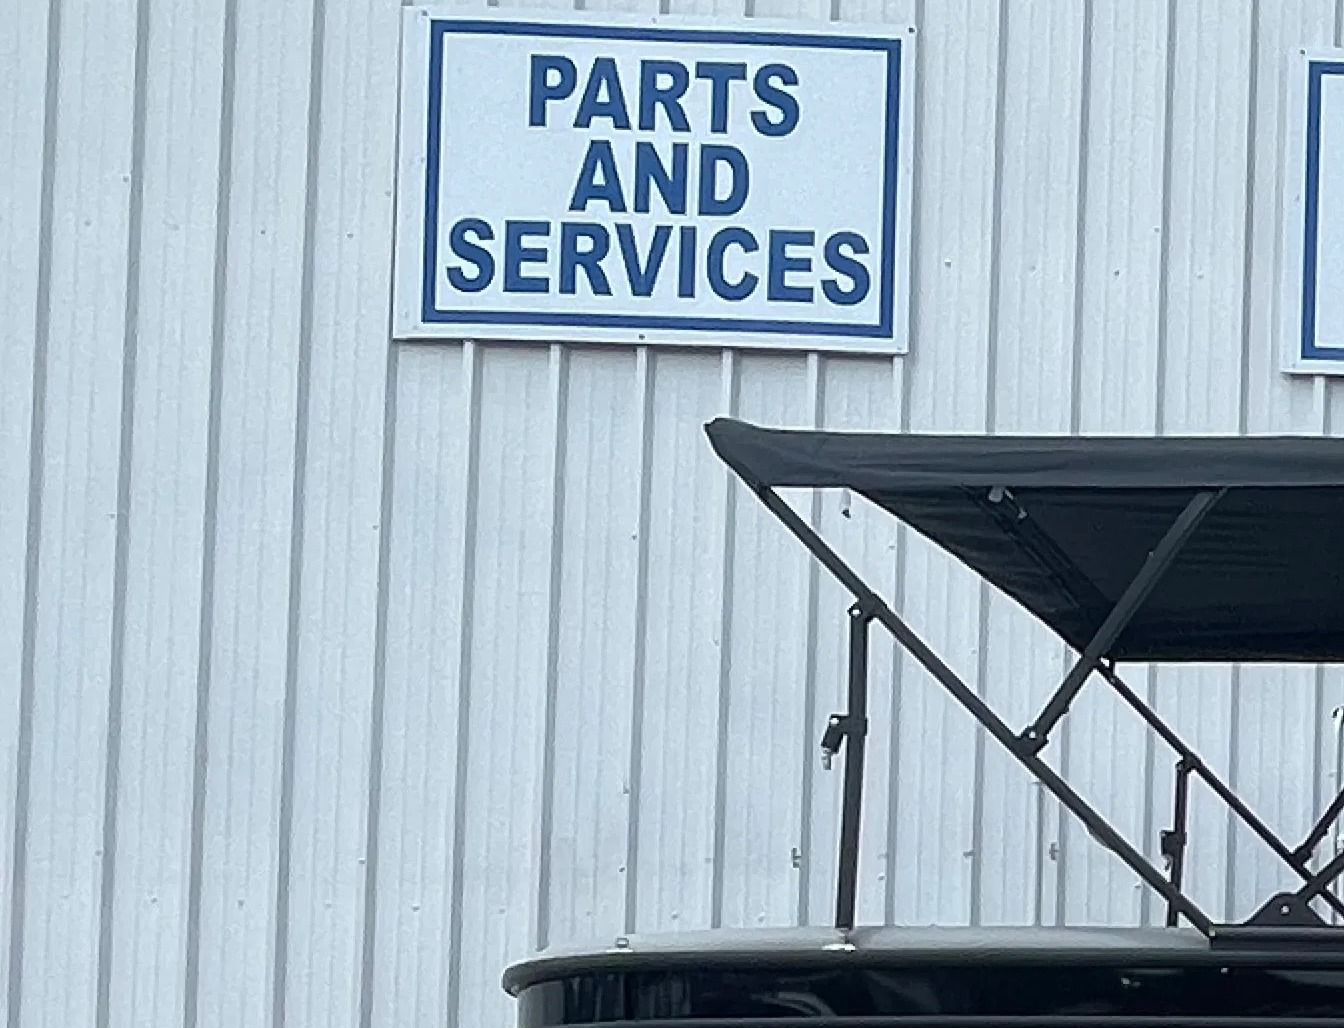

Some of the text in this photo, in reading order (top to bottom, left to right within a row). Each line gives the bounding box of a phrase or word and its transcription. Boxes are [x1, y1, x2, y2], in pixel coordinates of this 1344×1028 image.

[529, 55, 800, 137] PARTS
[569, 140, 750, 217] AND
[447, 218, 871, 306] SERVICES
